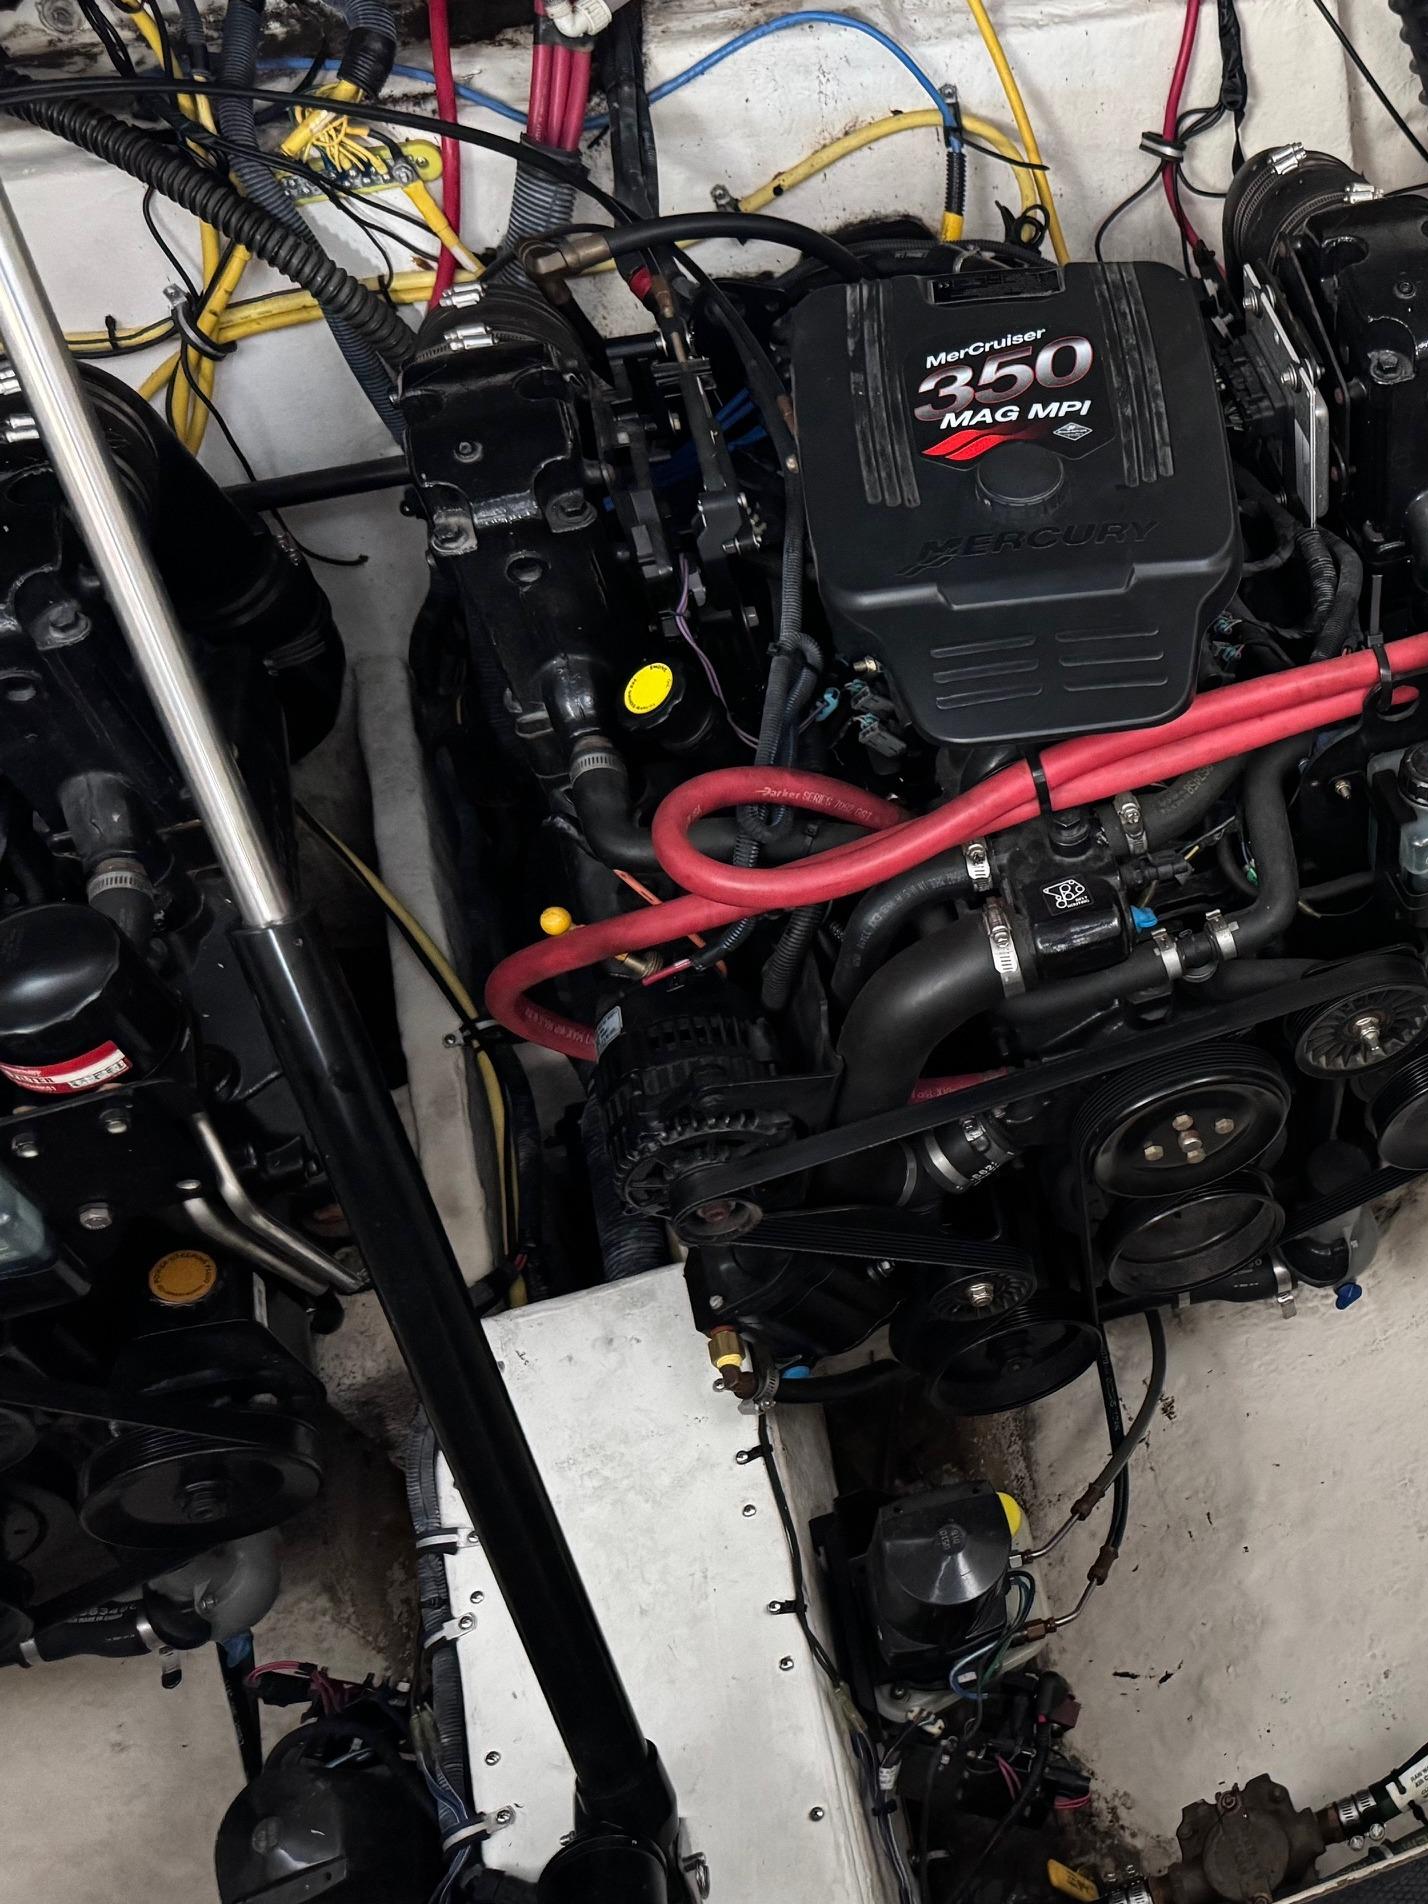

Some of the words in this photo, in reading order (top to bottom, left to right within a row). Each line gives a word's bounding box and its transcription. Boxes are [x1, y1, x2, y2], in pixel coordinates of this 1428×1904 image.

[926, 328, 1046, 369] MerCruiser
[914, 335, 1094, 422] 350
[939, 405, 1020, 430] MAG
[1027, 400, 1092, 420] MPI
[897, 519, 1160, 576] MERCURY
[755, 785, 800, 799] Parker
[801, 790, 832, 807] SERIES
